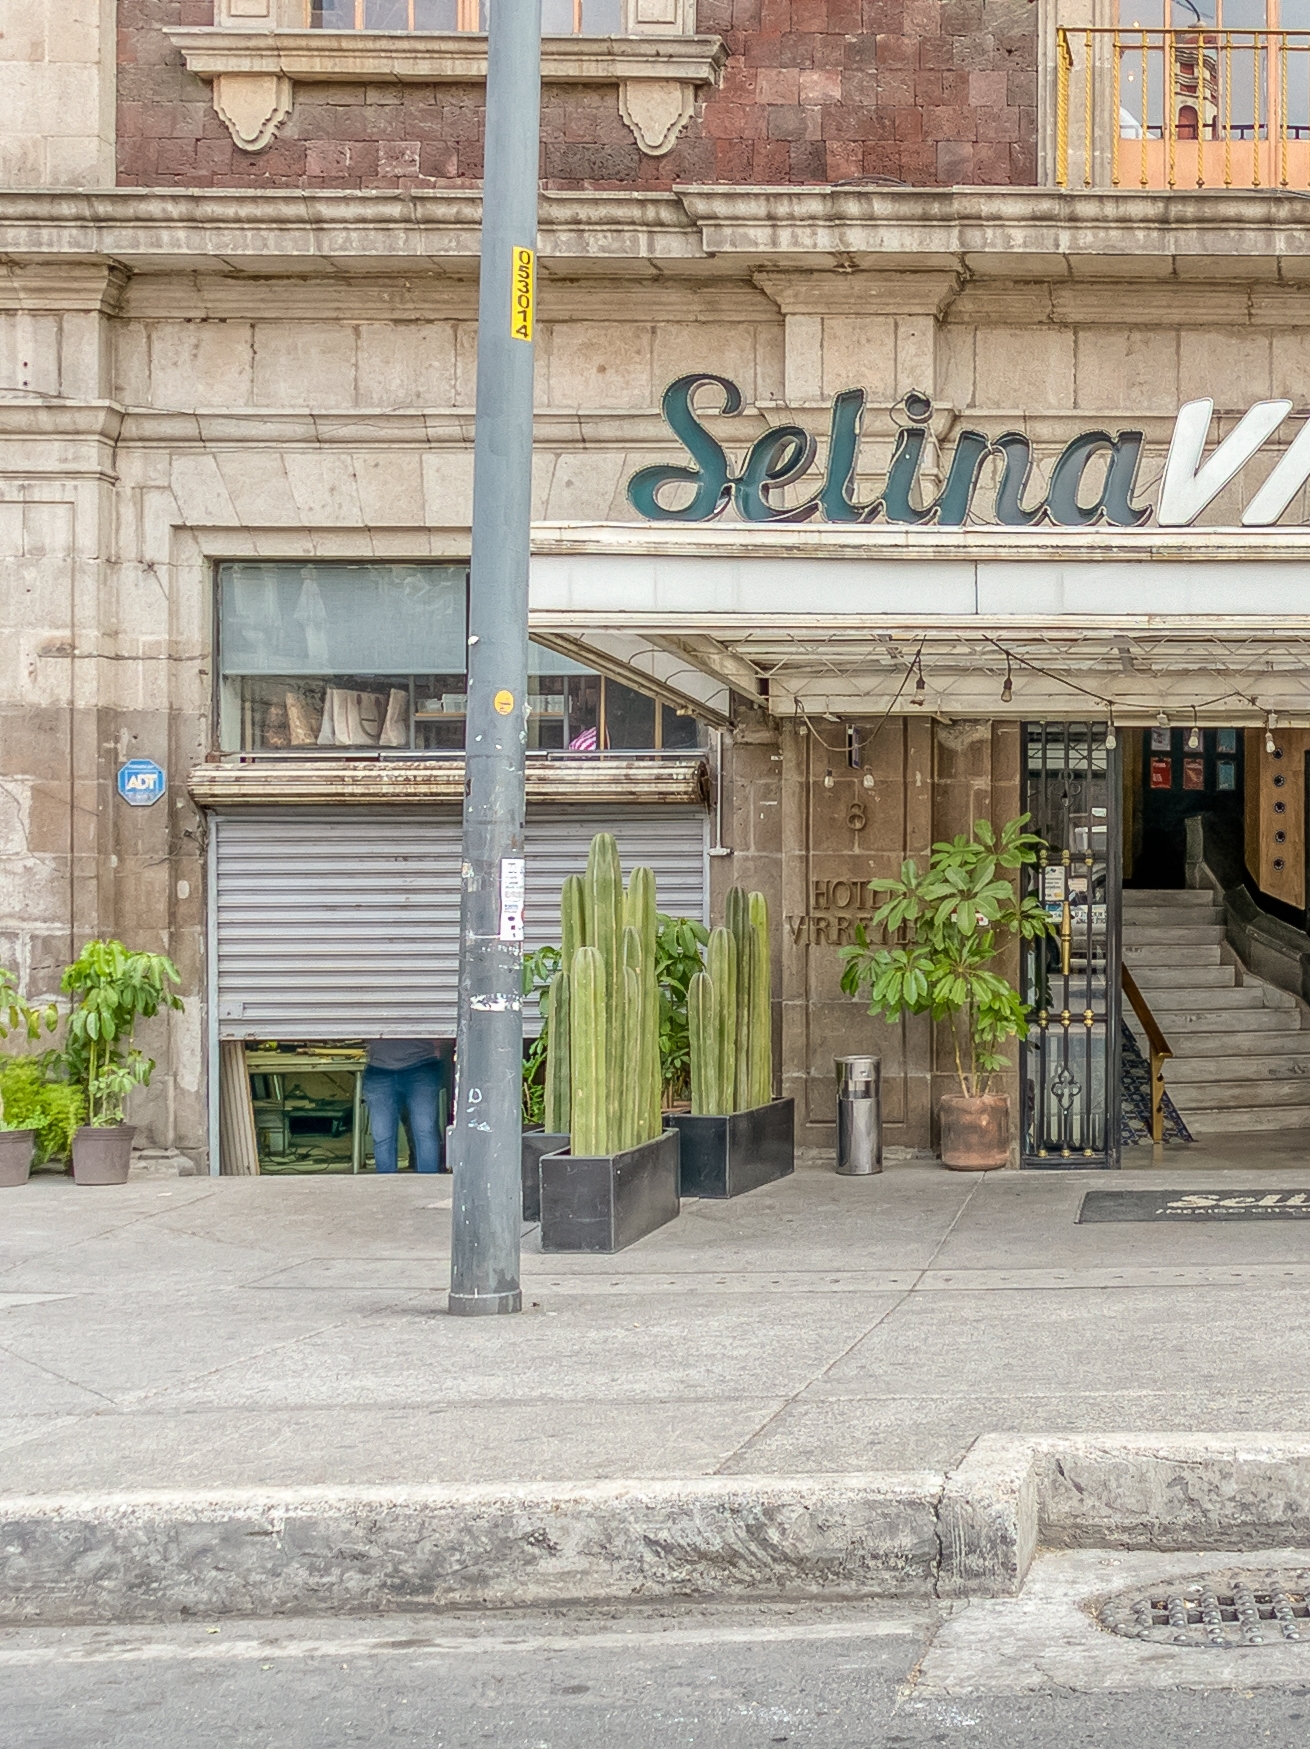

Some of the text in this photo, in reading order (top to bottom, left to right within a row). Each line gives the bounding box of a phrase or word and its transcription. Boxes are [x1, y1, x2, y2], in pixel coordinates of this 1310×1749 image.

[515, 250, 531, 338] 053014
[626, 372, 1154, 526] Selina
[126, 773, 158, 790] ADT
[846, 802, 867, 831] 8
